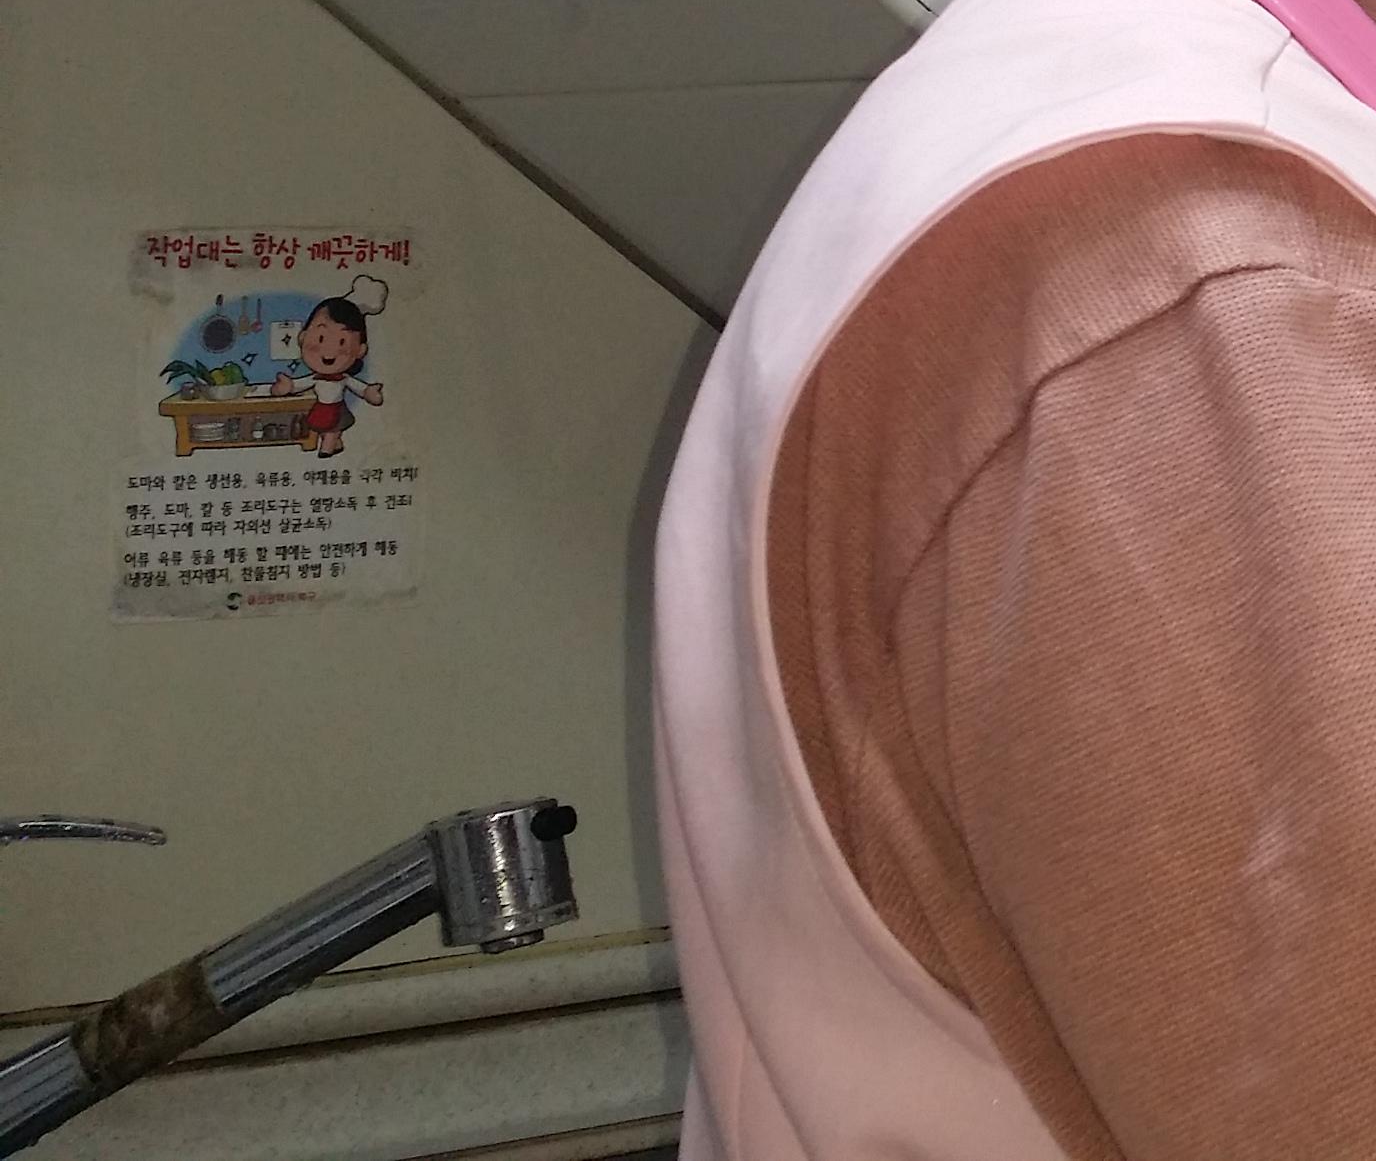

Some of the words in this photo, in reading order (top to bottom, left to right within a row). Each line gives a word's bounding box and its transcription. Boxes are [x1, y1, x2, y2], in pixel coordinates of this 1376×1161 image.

[147, 235, 243, 269] 작업대는
[253, 233, 301, 270] 항상
[307, 235, 409, 270] 깨끗하게!
[127, 475, 165, 491] 도마와
[172, 474, 197, 491] 칼은
[303, 469, 351, 485] 야채용을
[360, 468, 383, 484] 각각
[200, 501, 214, 518] 칼
[221, 501, 233, 517] 등
[241, 498, 302, 515] 조리도구는
[310, 496, 357, 513] 열탕소독
[365, 495, 377, 510] 후
[125, 521, 194, 539] (조리도구에
[200, 520, 227, 536] 따라
[232, 518, 271, 535] 자외선
[279, 516, 332, 533] 살균소독)
[124, 551, 149, 568] 어류
[158, 550, 183, 567] 육류
[191, 549, 216, 566] 등을
[223, 547, 248, 564] 해동
[256, 546, 268, 562] 할
[319, 541, 368, 559] 안전하게
[374, 539, 400, 556] 해동
[297, 562, 322, 579] 방법
